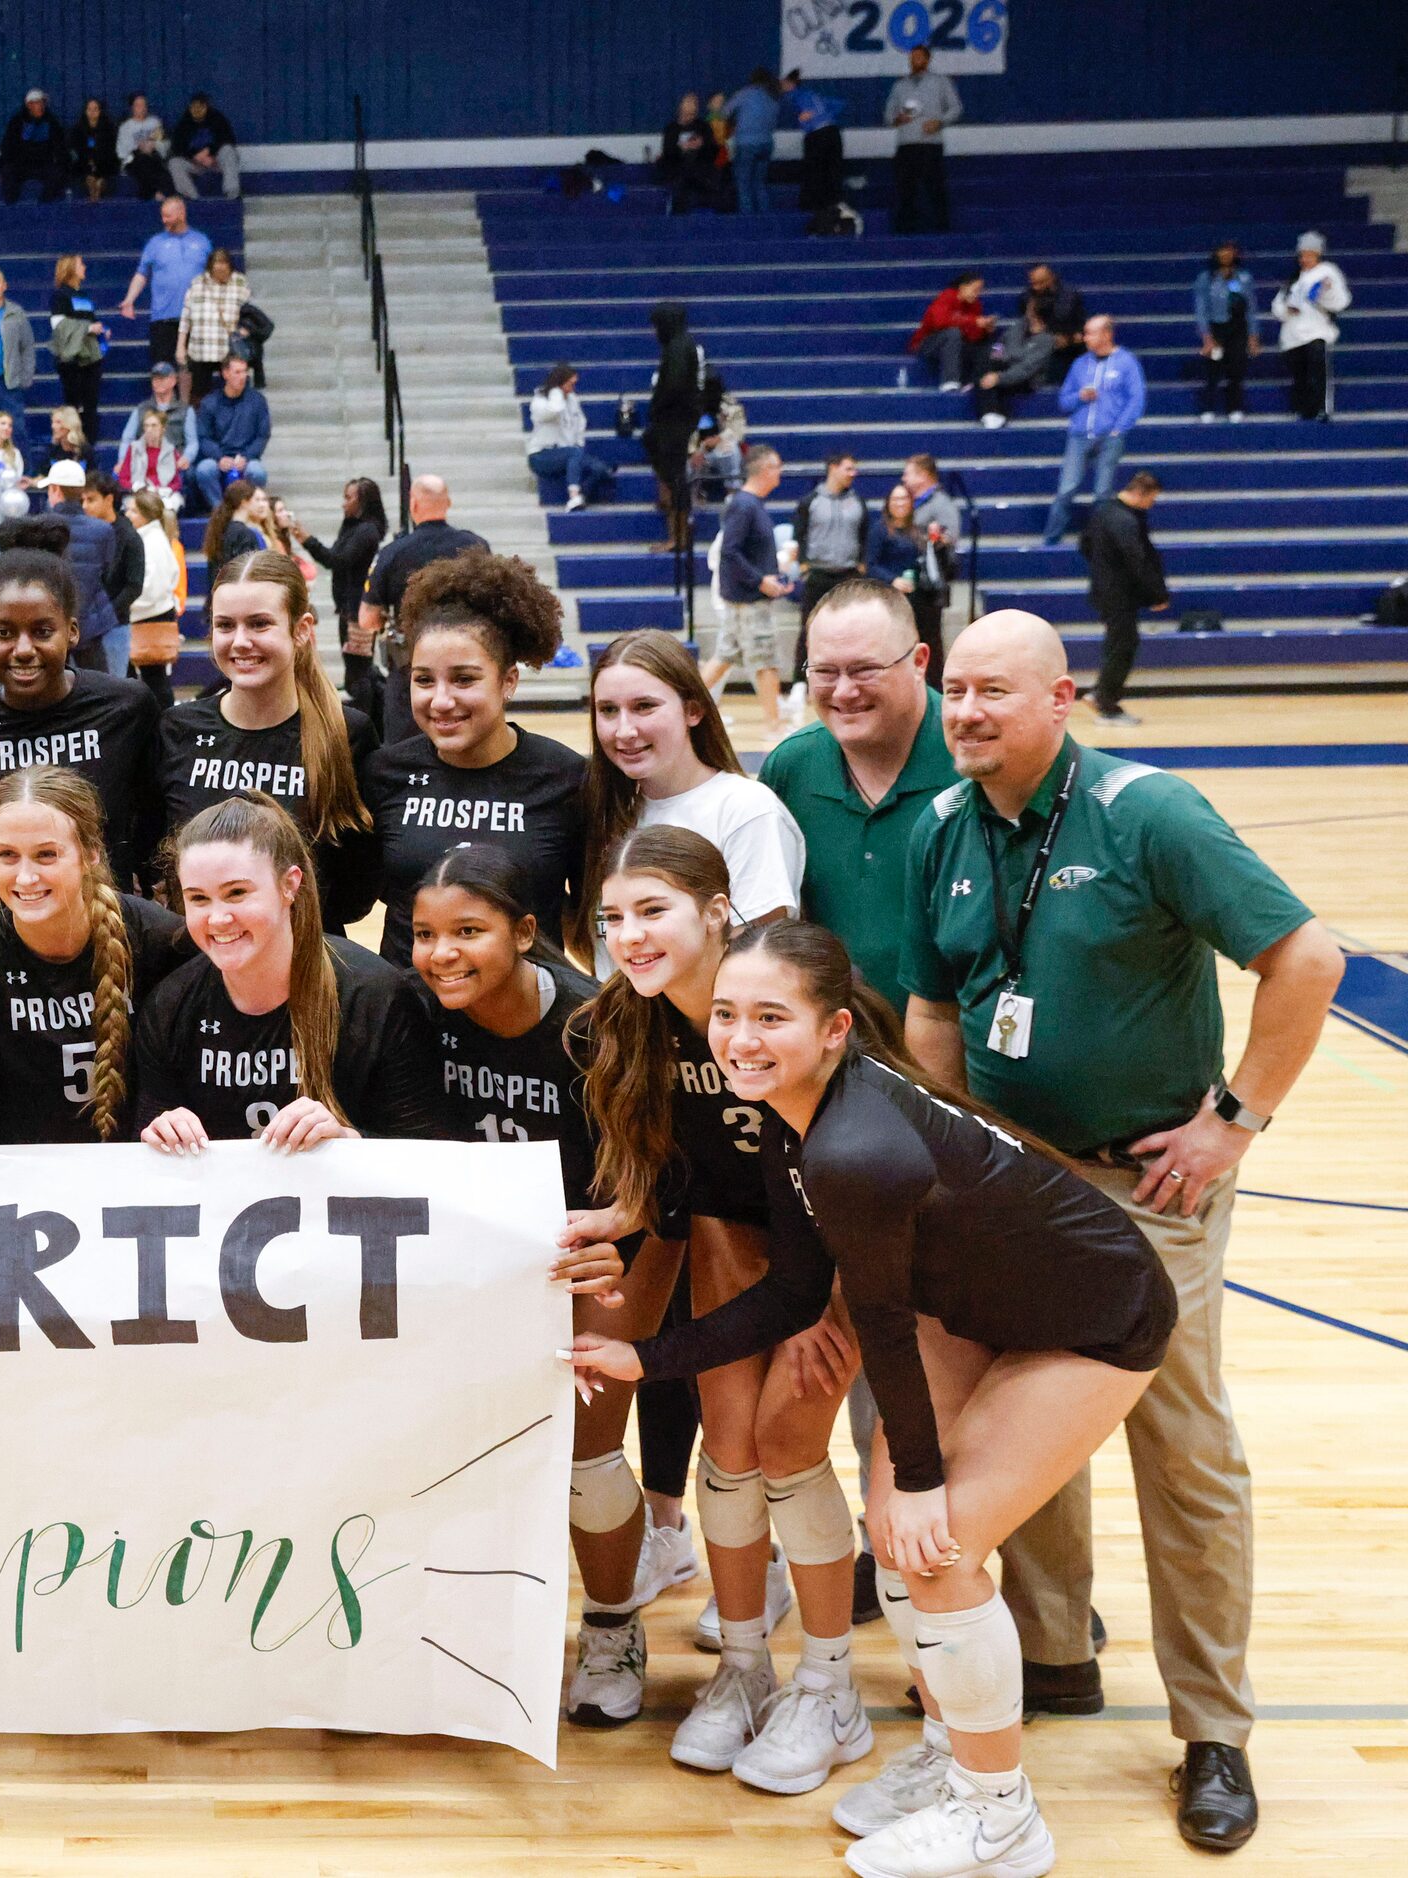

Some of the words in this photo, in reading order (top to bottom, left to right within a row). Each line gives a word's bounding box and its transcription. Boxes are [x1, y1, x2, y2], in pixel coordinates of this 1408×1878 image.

[845, 0, 1006, 53] 2026
[189, 758, 306, 797] PROSPER
[402, 797, 525, 832] PROSPER
[62, 1041, 97, 1102] 5
[444, 1060, 561, 1115] PROSPER
[722, 1106, 763, 1153] 3
